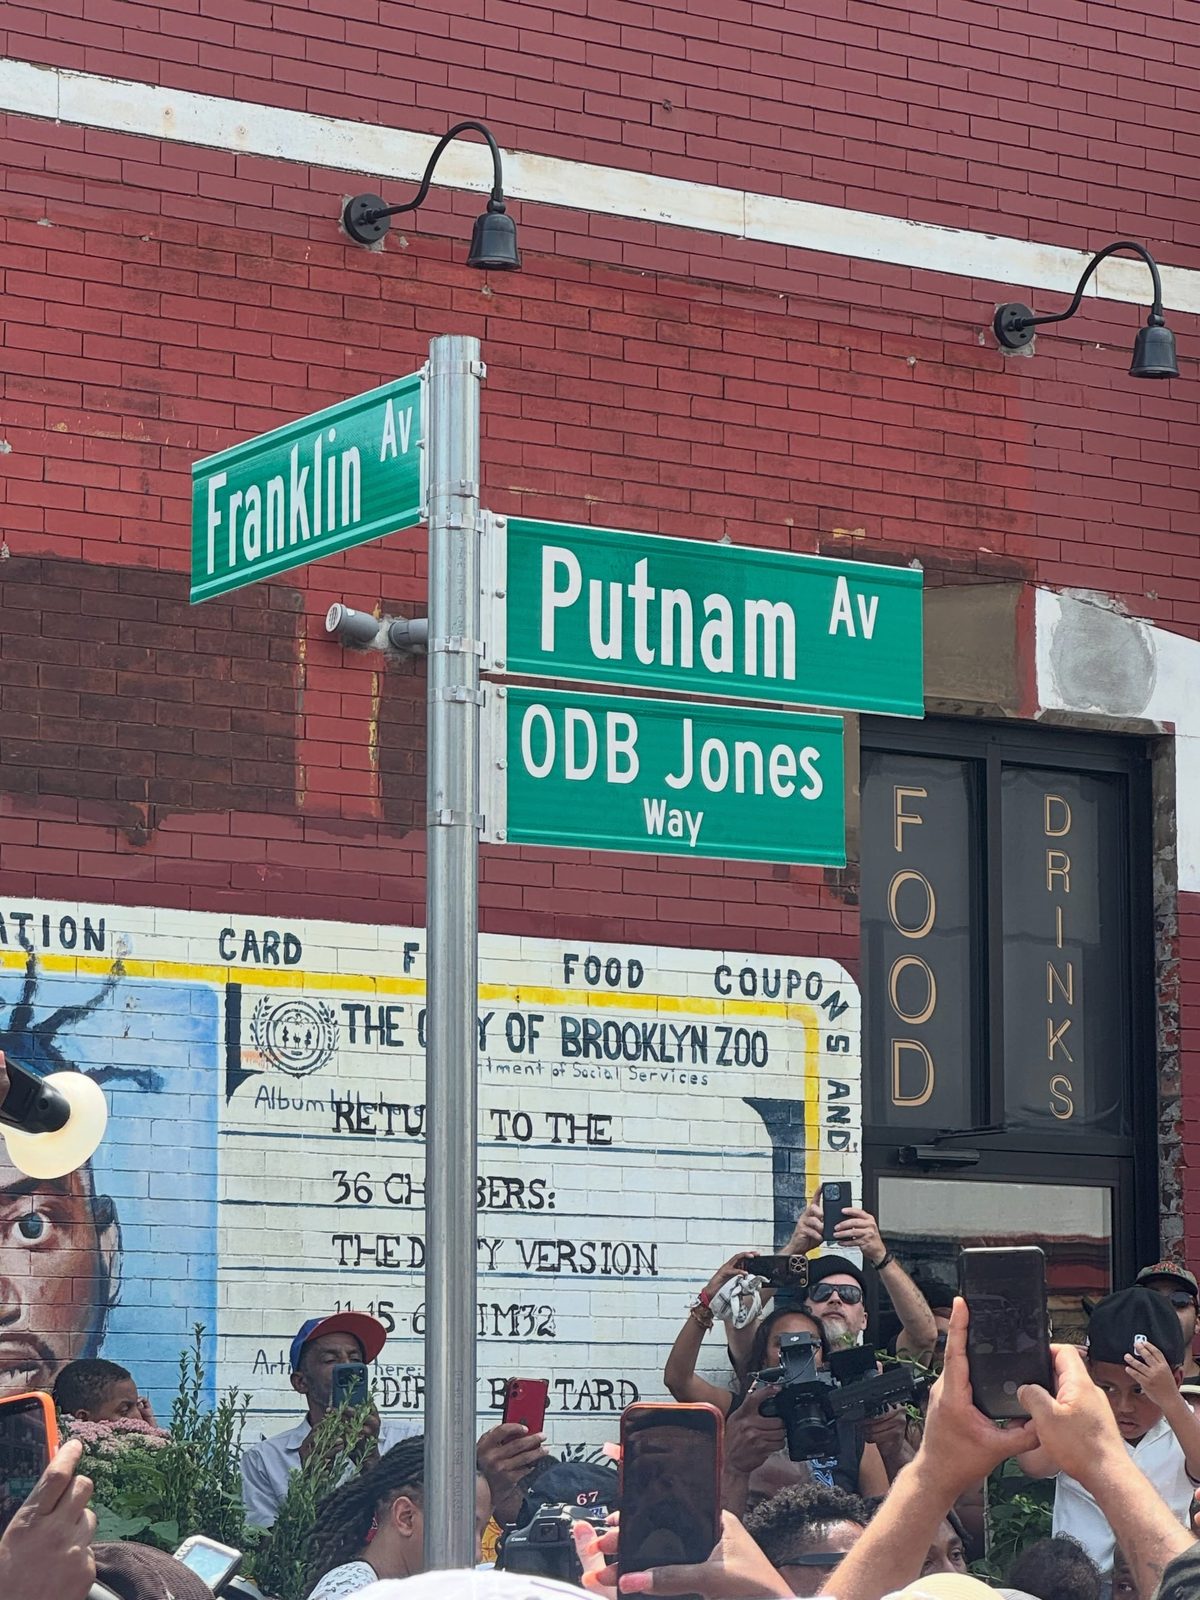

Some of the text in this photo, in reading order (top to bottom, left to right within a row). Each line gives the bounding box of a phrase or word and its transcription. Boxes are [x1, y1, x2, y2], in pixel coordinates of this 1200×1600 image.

[207, 398, 413, 575] Franklin Av
[541, 545, 796, 680] Putnam
[828, 575, 879, 640] Av
[521, 704, 823, 800] ODB Jones
[643, 798, 704, 847] Way
[219, 927, 302, 965] CARD
[563, 953, 644, 988] FOOD
[887, 785, 937, 1106] FOOD
[1044, 793, 1074, 1120] DRINKS
[341, 1003, 404, 1047] THE
[505, 1012, 545, 1054] OF
[561, 1015, 708, 1066] BROOKLYN
[714, 1026, 768, 1068] ZOO
[254, 1085, 325, 1112] Album
[552, 1063, 566, 1077] of
[573, 1064, 619, 1080] Social
[629, 1066, 708, 1086] Services
[490, 1109, 533, 1142] TO
[546, 1113, 612, 1145] THE
[332, 1170, 373, 1204] 36
[332, 1234, 400, 1268] THE
[516, 1239, 659, 1276] VERSION
[576, 1491, 599, 1506] 67
